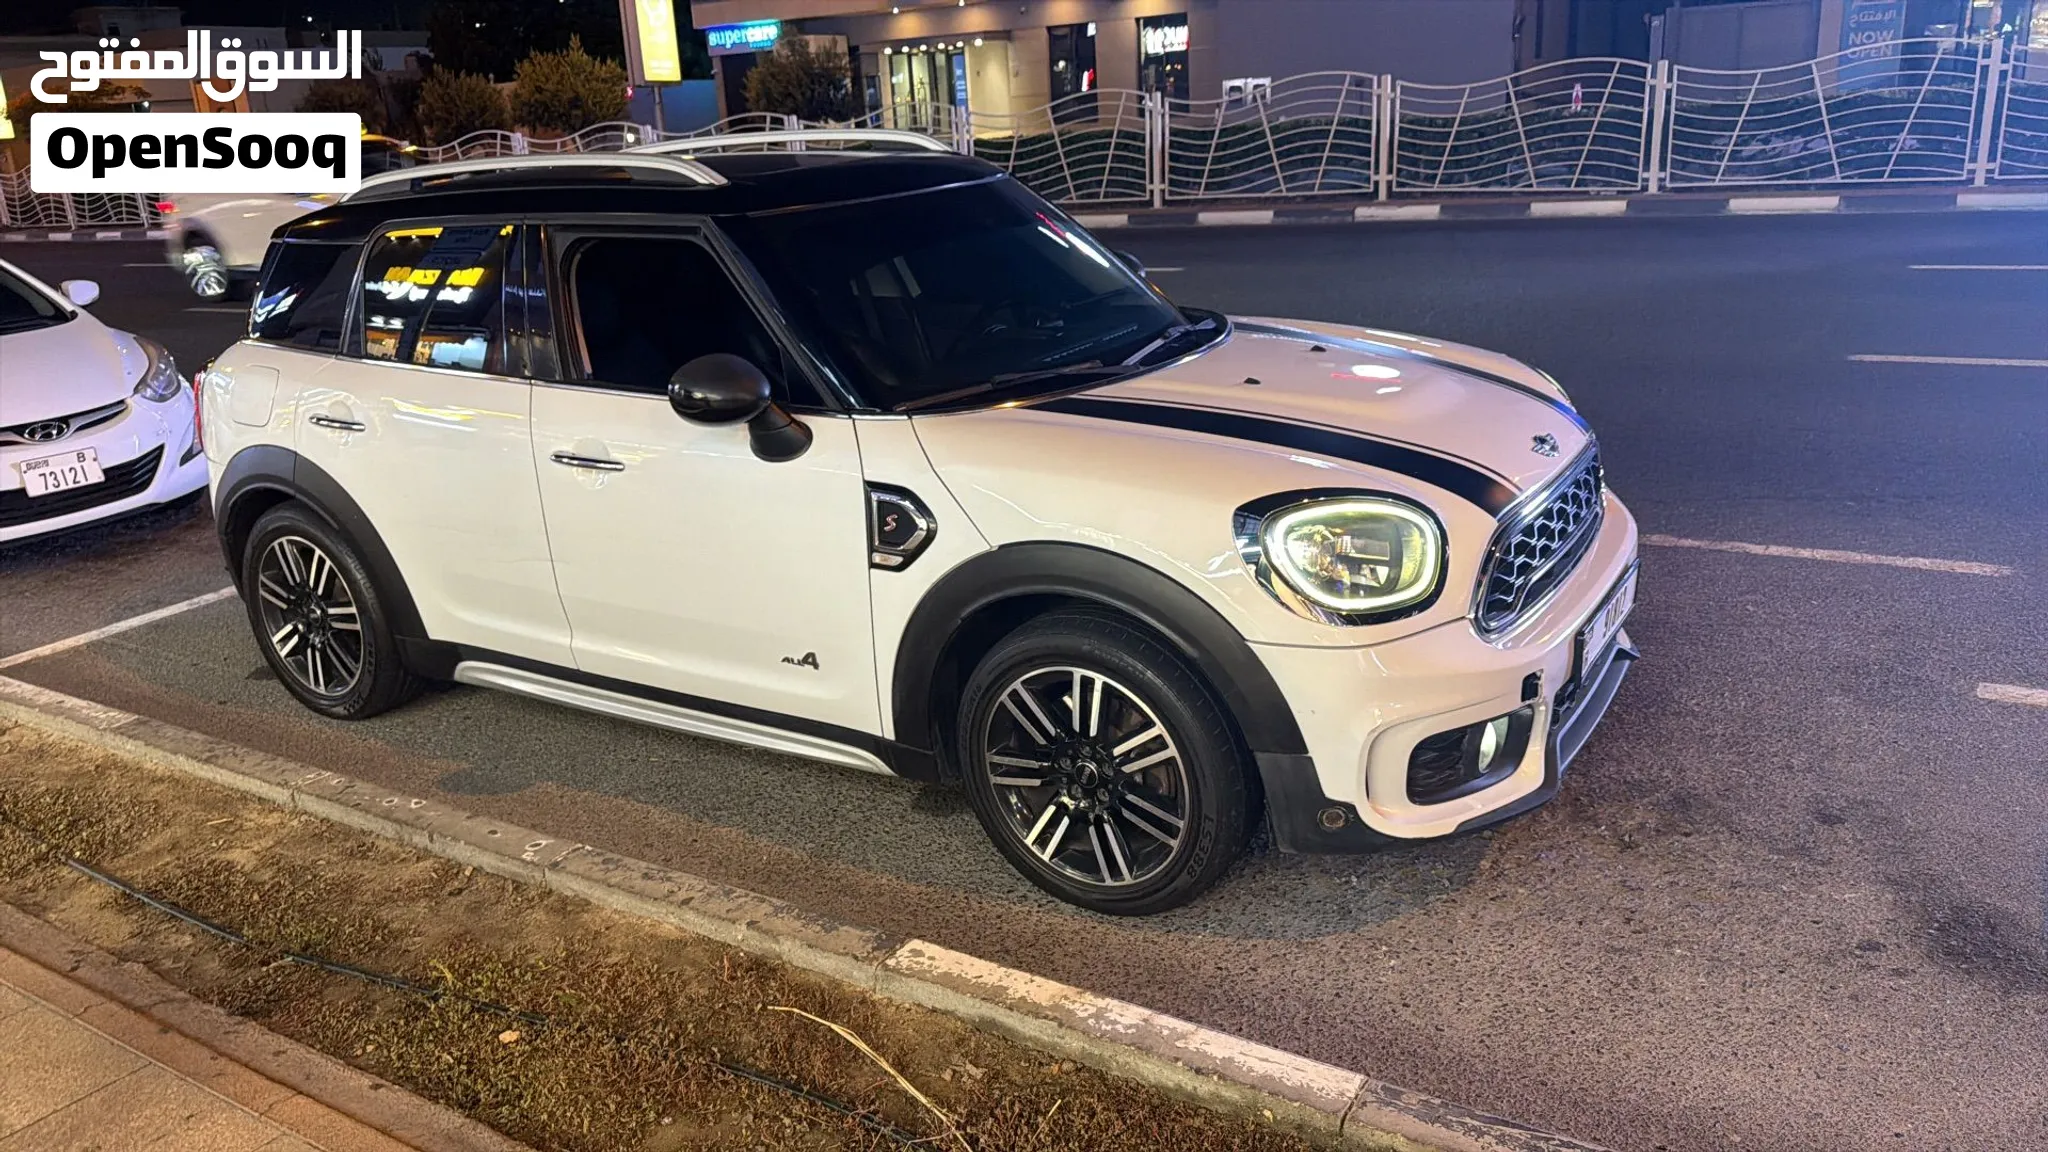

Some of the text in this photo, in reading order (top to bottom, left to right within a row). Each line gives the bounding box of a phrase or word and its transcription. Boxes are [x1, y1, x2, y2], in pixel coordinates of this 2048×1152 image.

[708, 25, 778, 49] supercare
[1849, 30, 1894, 45] NOW
[76, 452, 86, 463] B
[39, 465, 88, 490] 73121
[883, 514, 898, 532] S
